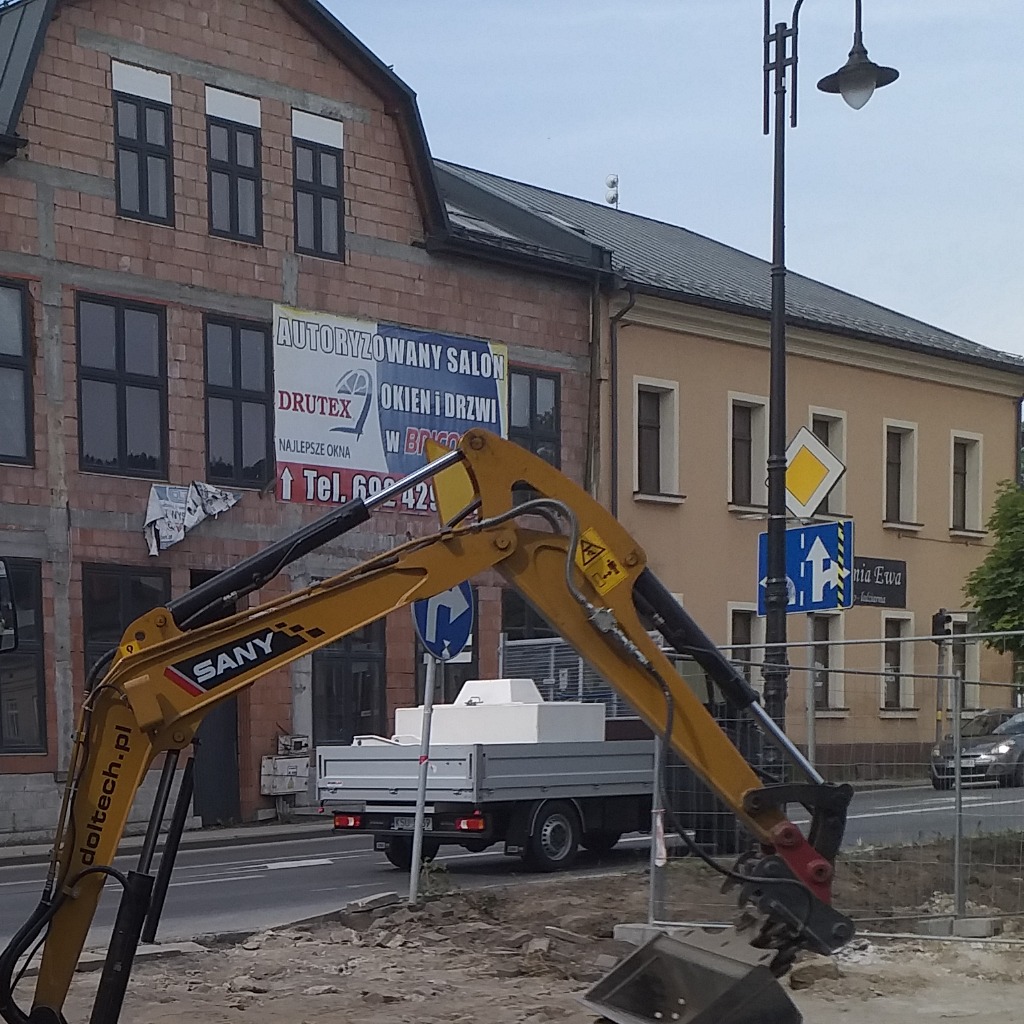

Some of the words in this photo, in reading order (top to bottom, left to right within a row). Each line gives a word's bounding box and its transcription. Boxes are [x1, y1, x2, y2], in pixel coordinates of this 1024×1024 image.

[276, 317, 442, 373] AUTORYZOWANY
[447, 346, 505, 381] SALON
[278, 390, 352, 419] DRUTEX
[381, 382, 431, 414] OKIEN
[434, 391, 441, 416] i
[444, 391, 497, 424] DRZWI
[278, 438, 325, 456] NAJLEPSZE
[326, 443, 351, 459] OKNA
[303, 468, 347, 504] Tel.
[873, 565, 902, 586] Ewa
[192, 631, 274, 684] SANY
[79, 724, 133, 866] doltech.pl
